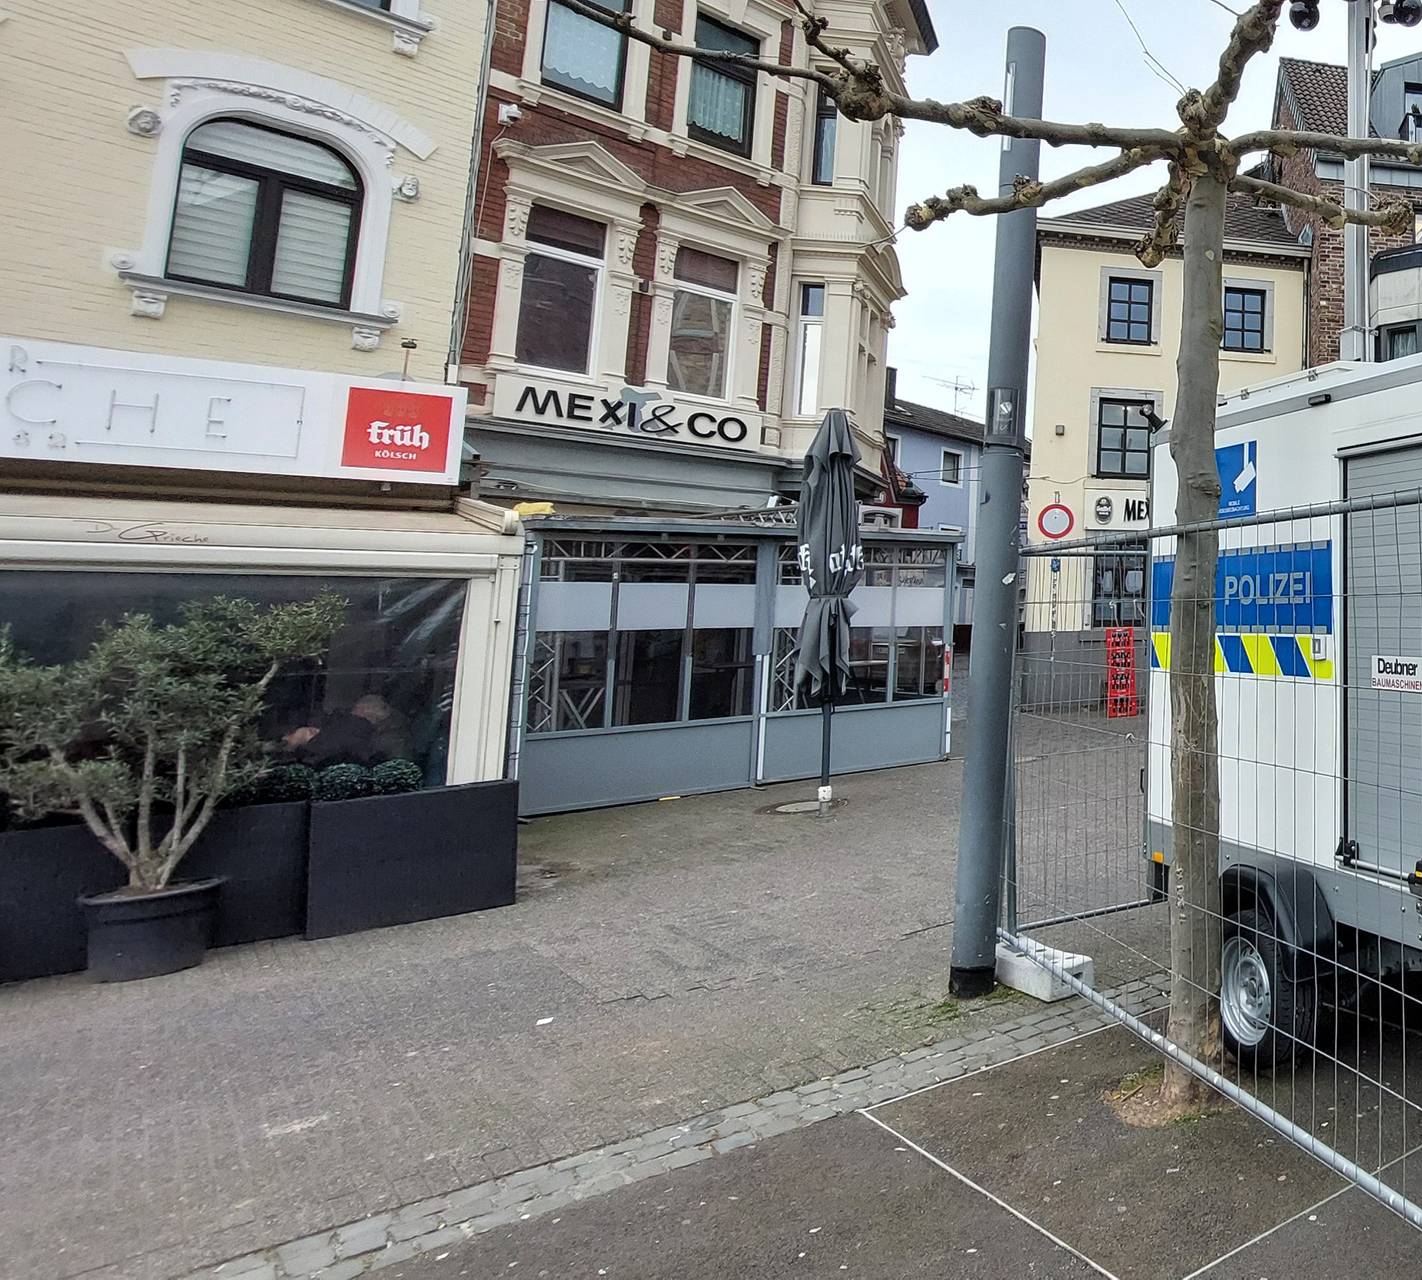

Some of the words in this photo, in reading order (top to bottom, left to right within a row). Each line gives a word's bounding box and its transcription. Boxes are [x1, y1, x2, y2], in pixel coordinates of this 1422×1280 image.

[374, 449, 417, 460] KÖLSCH
[1224, 571, 1311, 606] POLIZEI
[1377, 657, 1418, 676] Deubner
